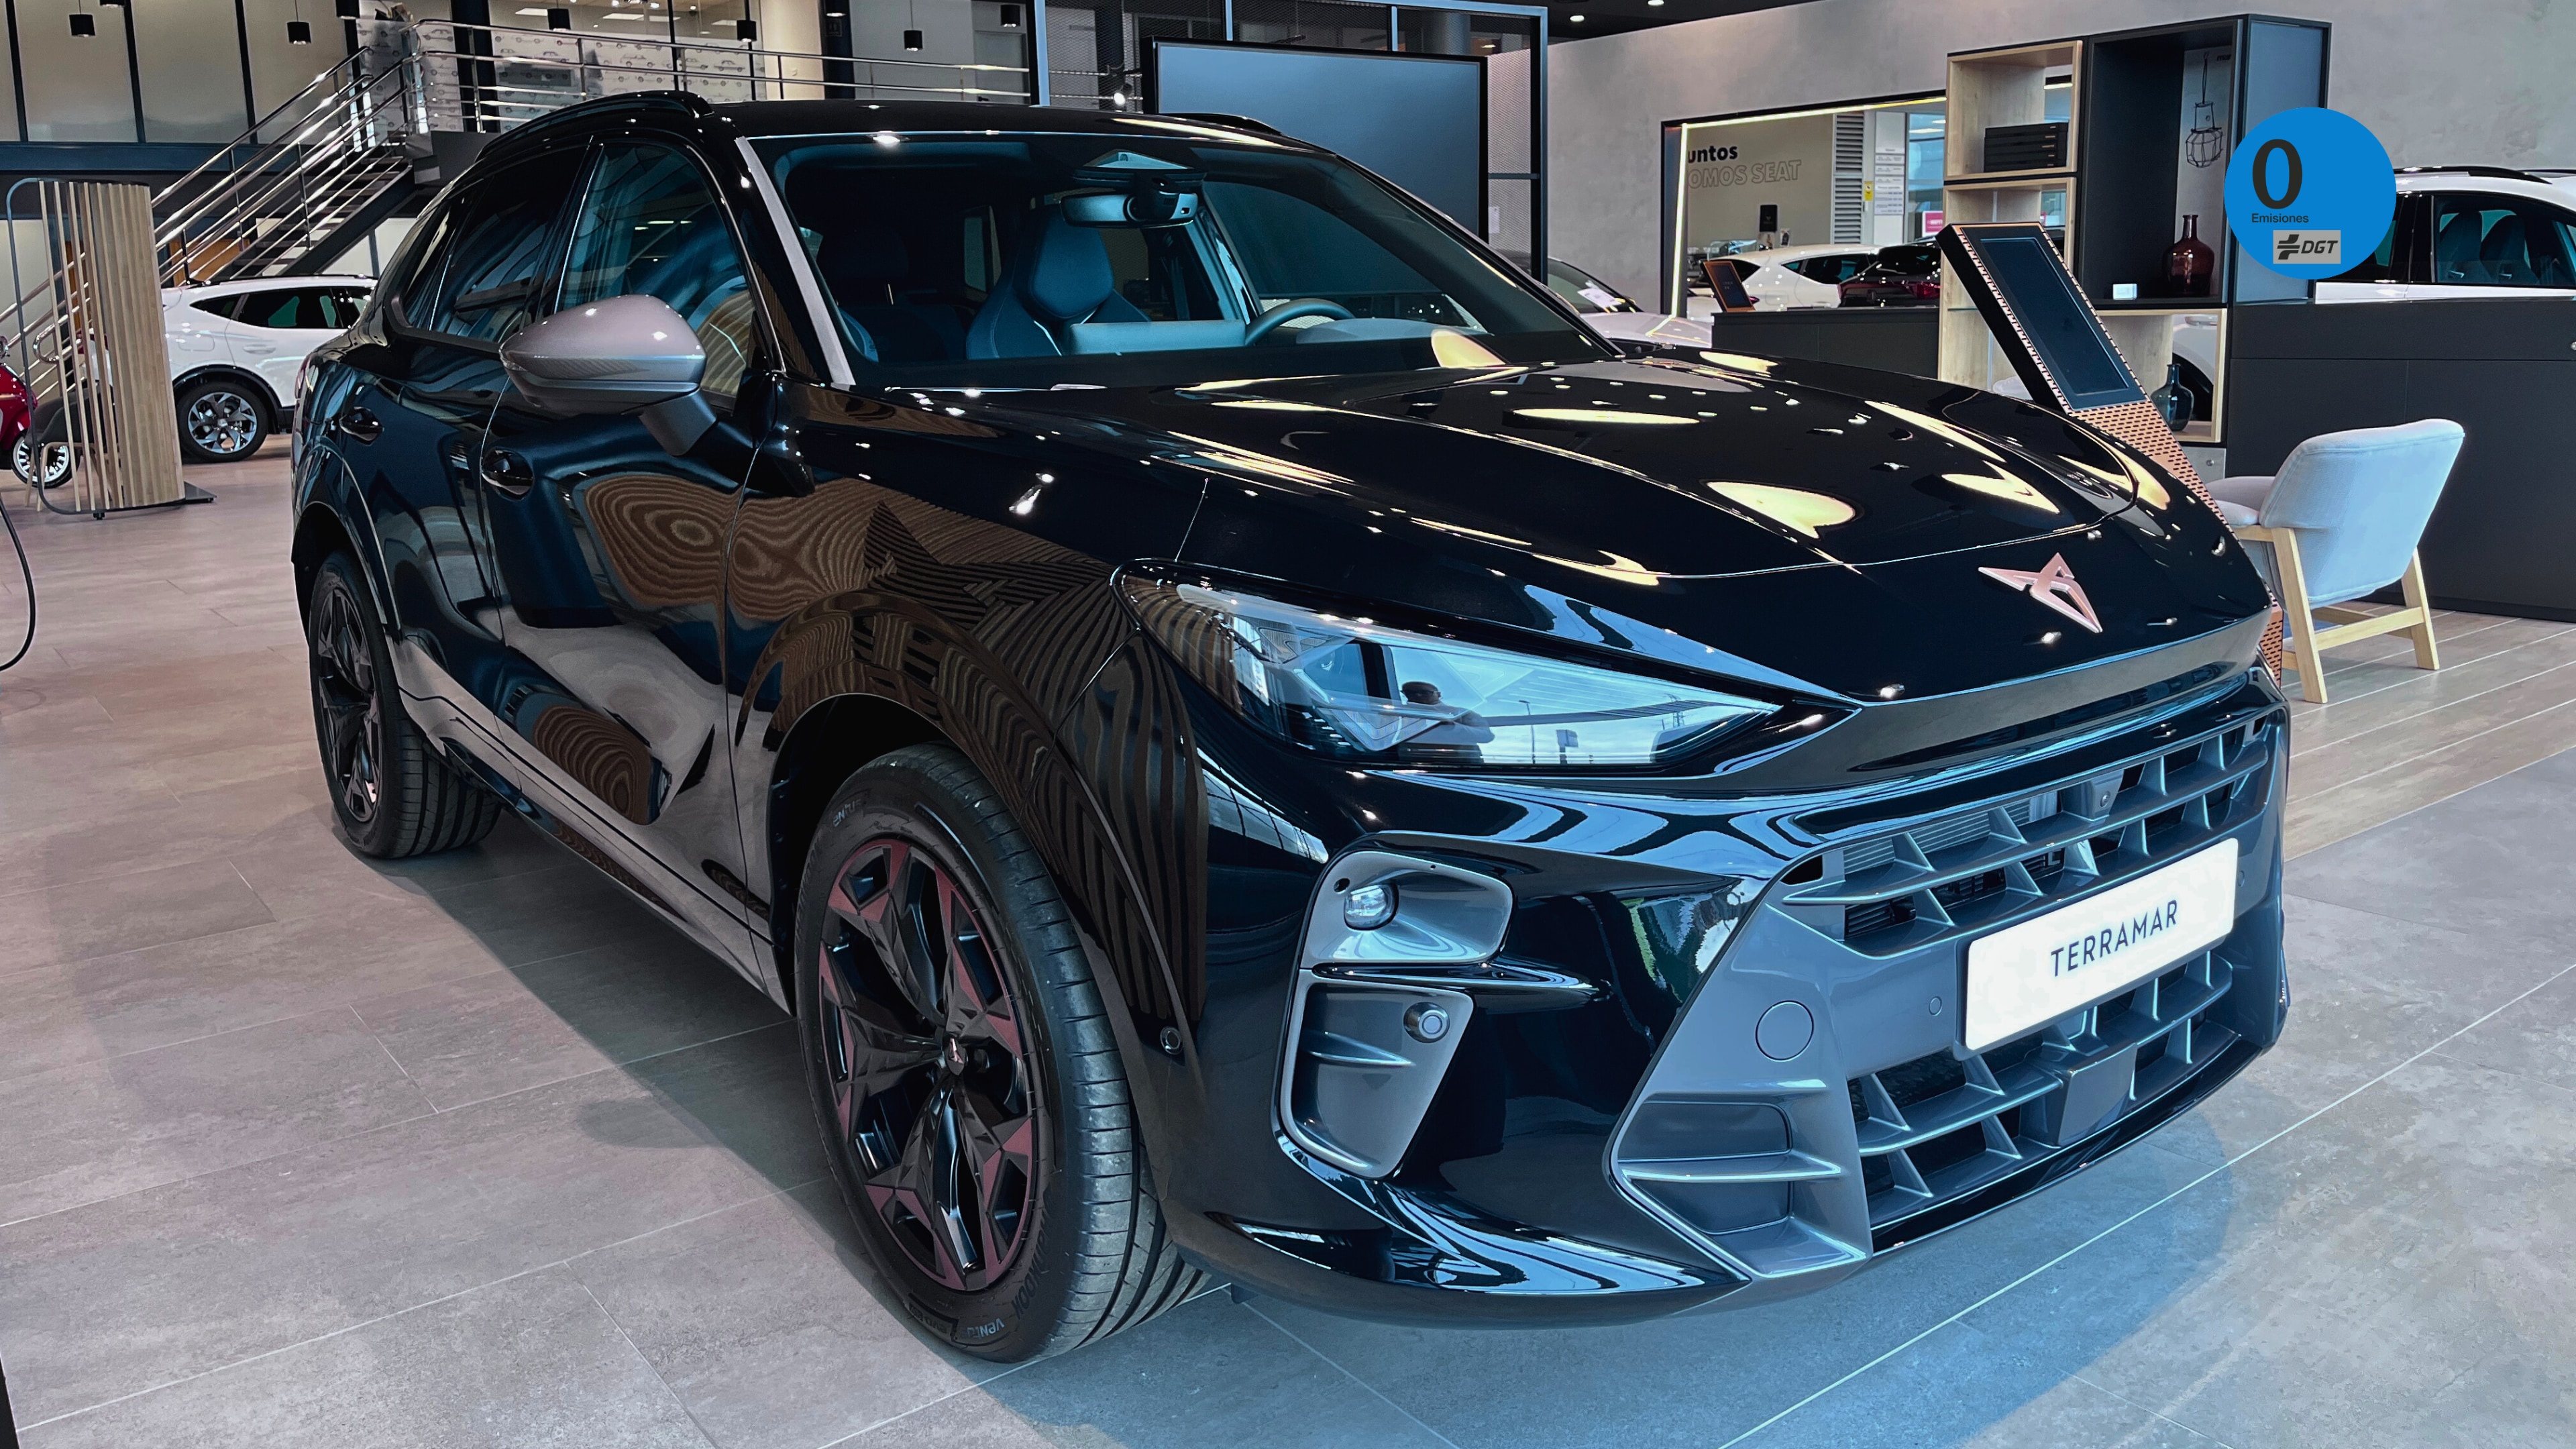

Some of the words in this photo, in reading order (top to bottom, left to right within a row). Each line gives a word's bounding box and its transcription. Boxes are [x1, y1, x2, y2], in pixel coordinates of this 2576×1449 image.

[1688, 165, 1748, 189] OMOS
[1751, 160, 1802, 184] SEAT
[2050, 900, 2178, 977] TERRAMAR
